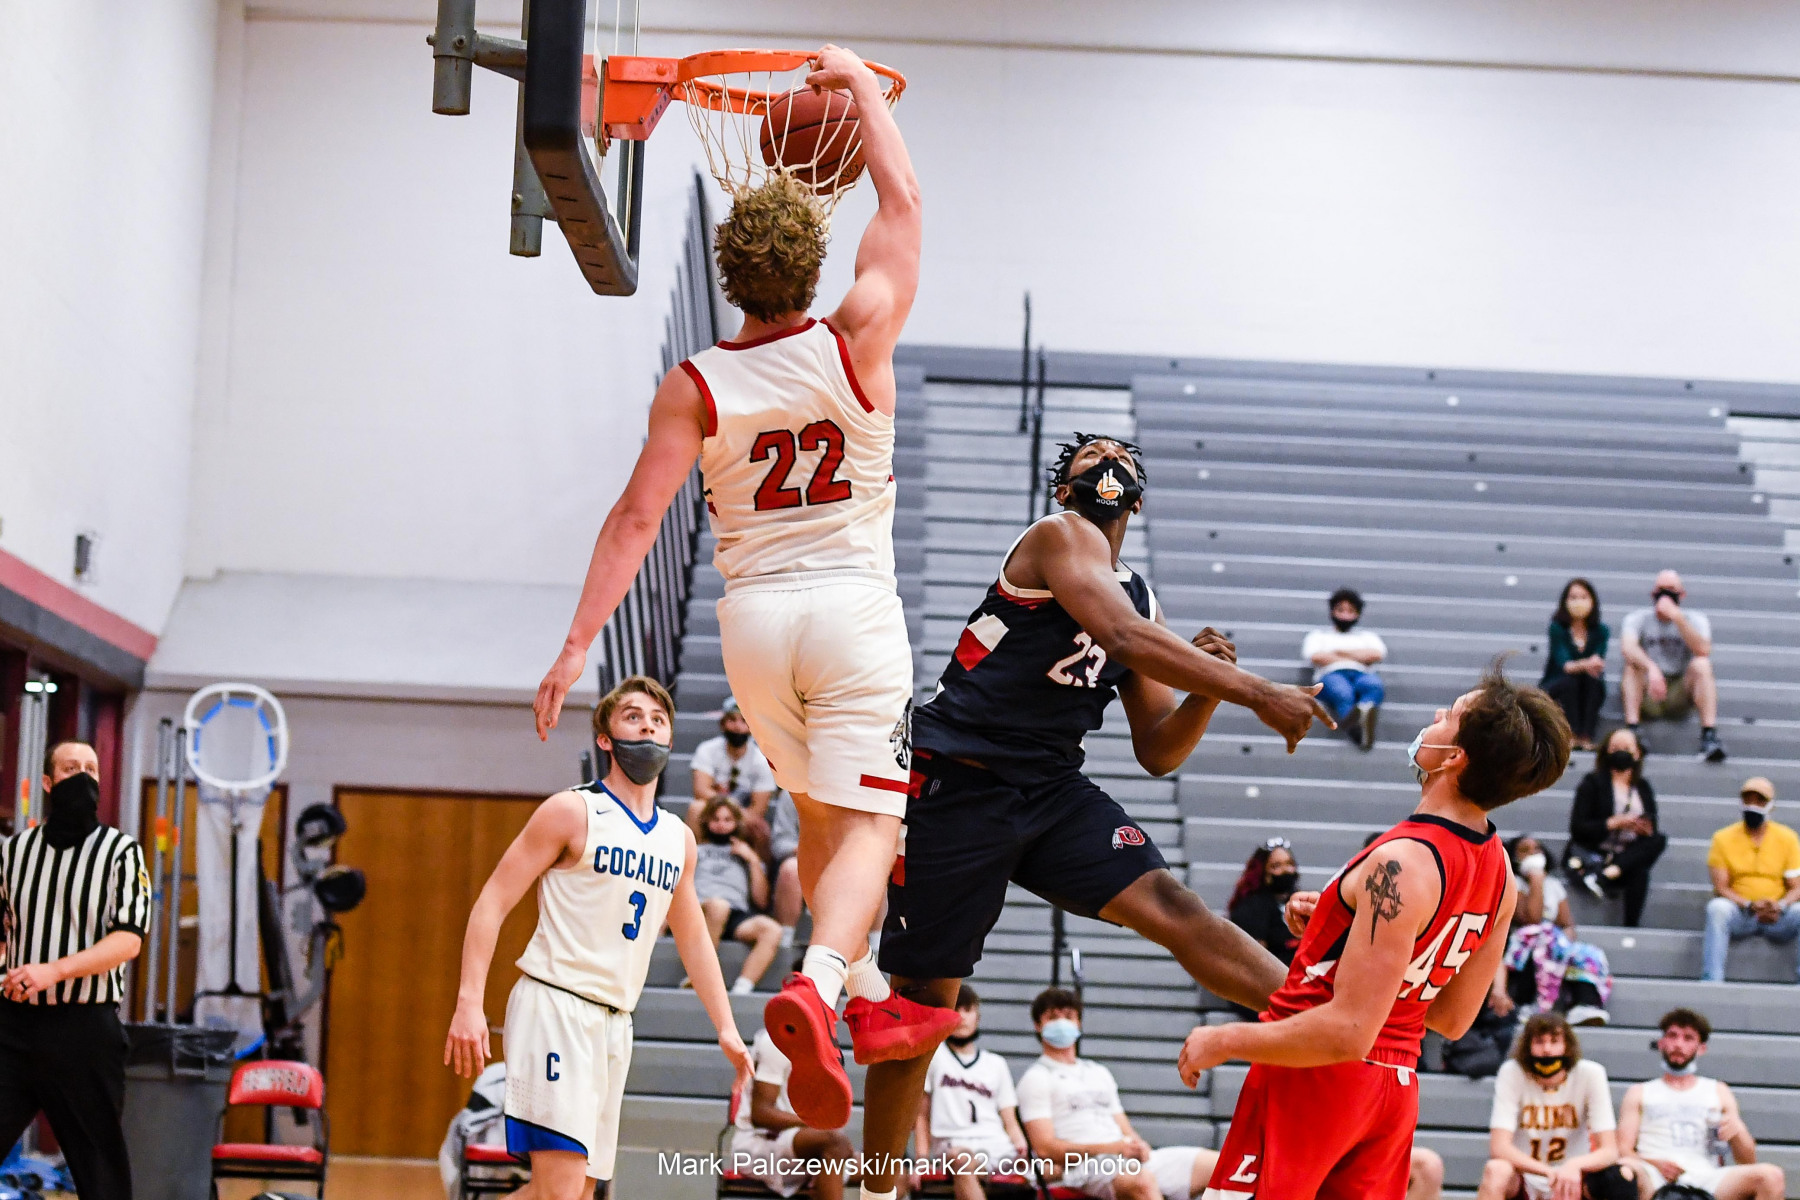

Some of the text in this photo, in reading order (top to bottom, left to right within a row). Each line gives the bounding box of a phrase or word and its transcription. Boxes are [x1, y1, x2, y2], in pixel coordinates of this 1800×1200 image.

[749, 418, 852, 512] 22
[1096, 498, 1119, 507] HOOPS
[1046, 631, 1106, 688] 23
[593, 845, 680, 894] COCALICO
[621, 890, 648, 942] 3
[1397, 912, 1489, 1002] 45
[546, 1052, 561, 1082] C
[1228, 1154, 1258, 1184] L
[1530, 1136, 1567, 1163] 12
